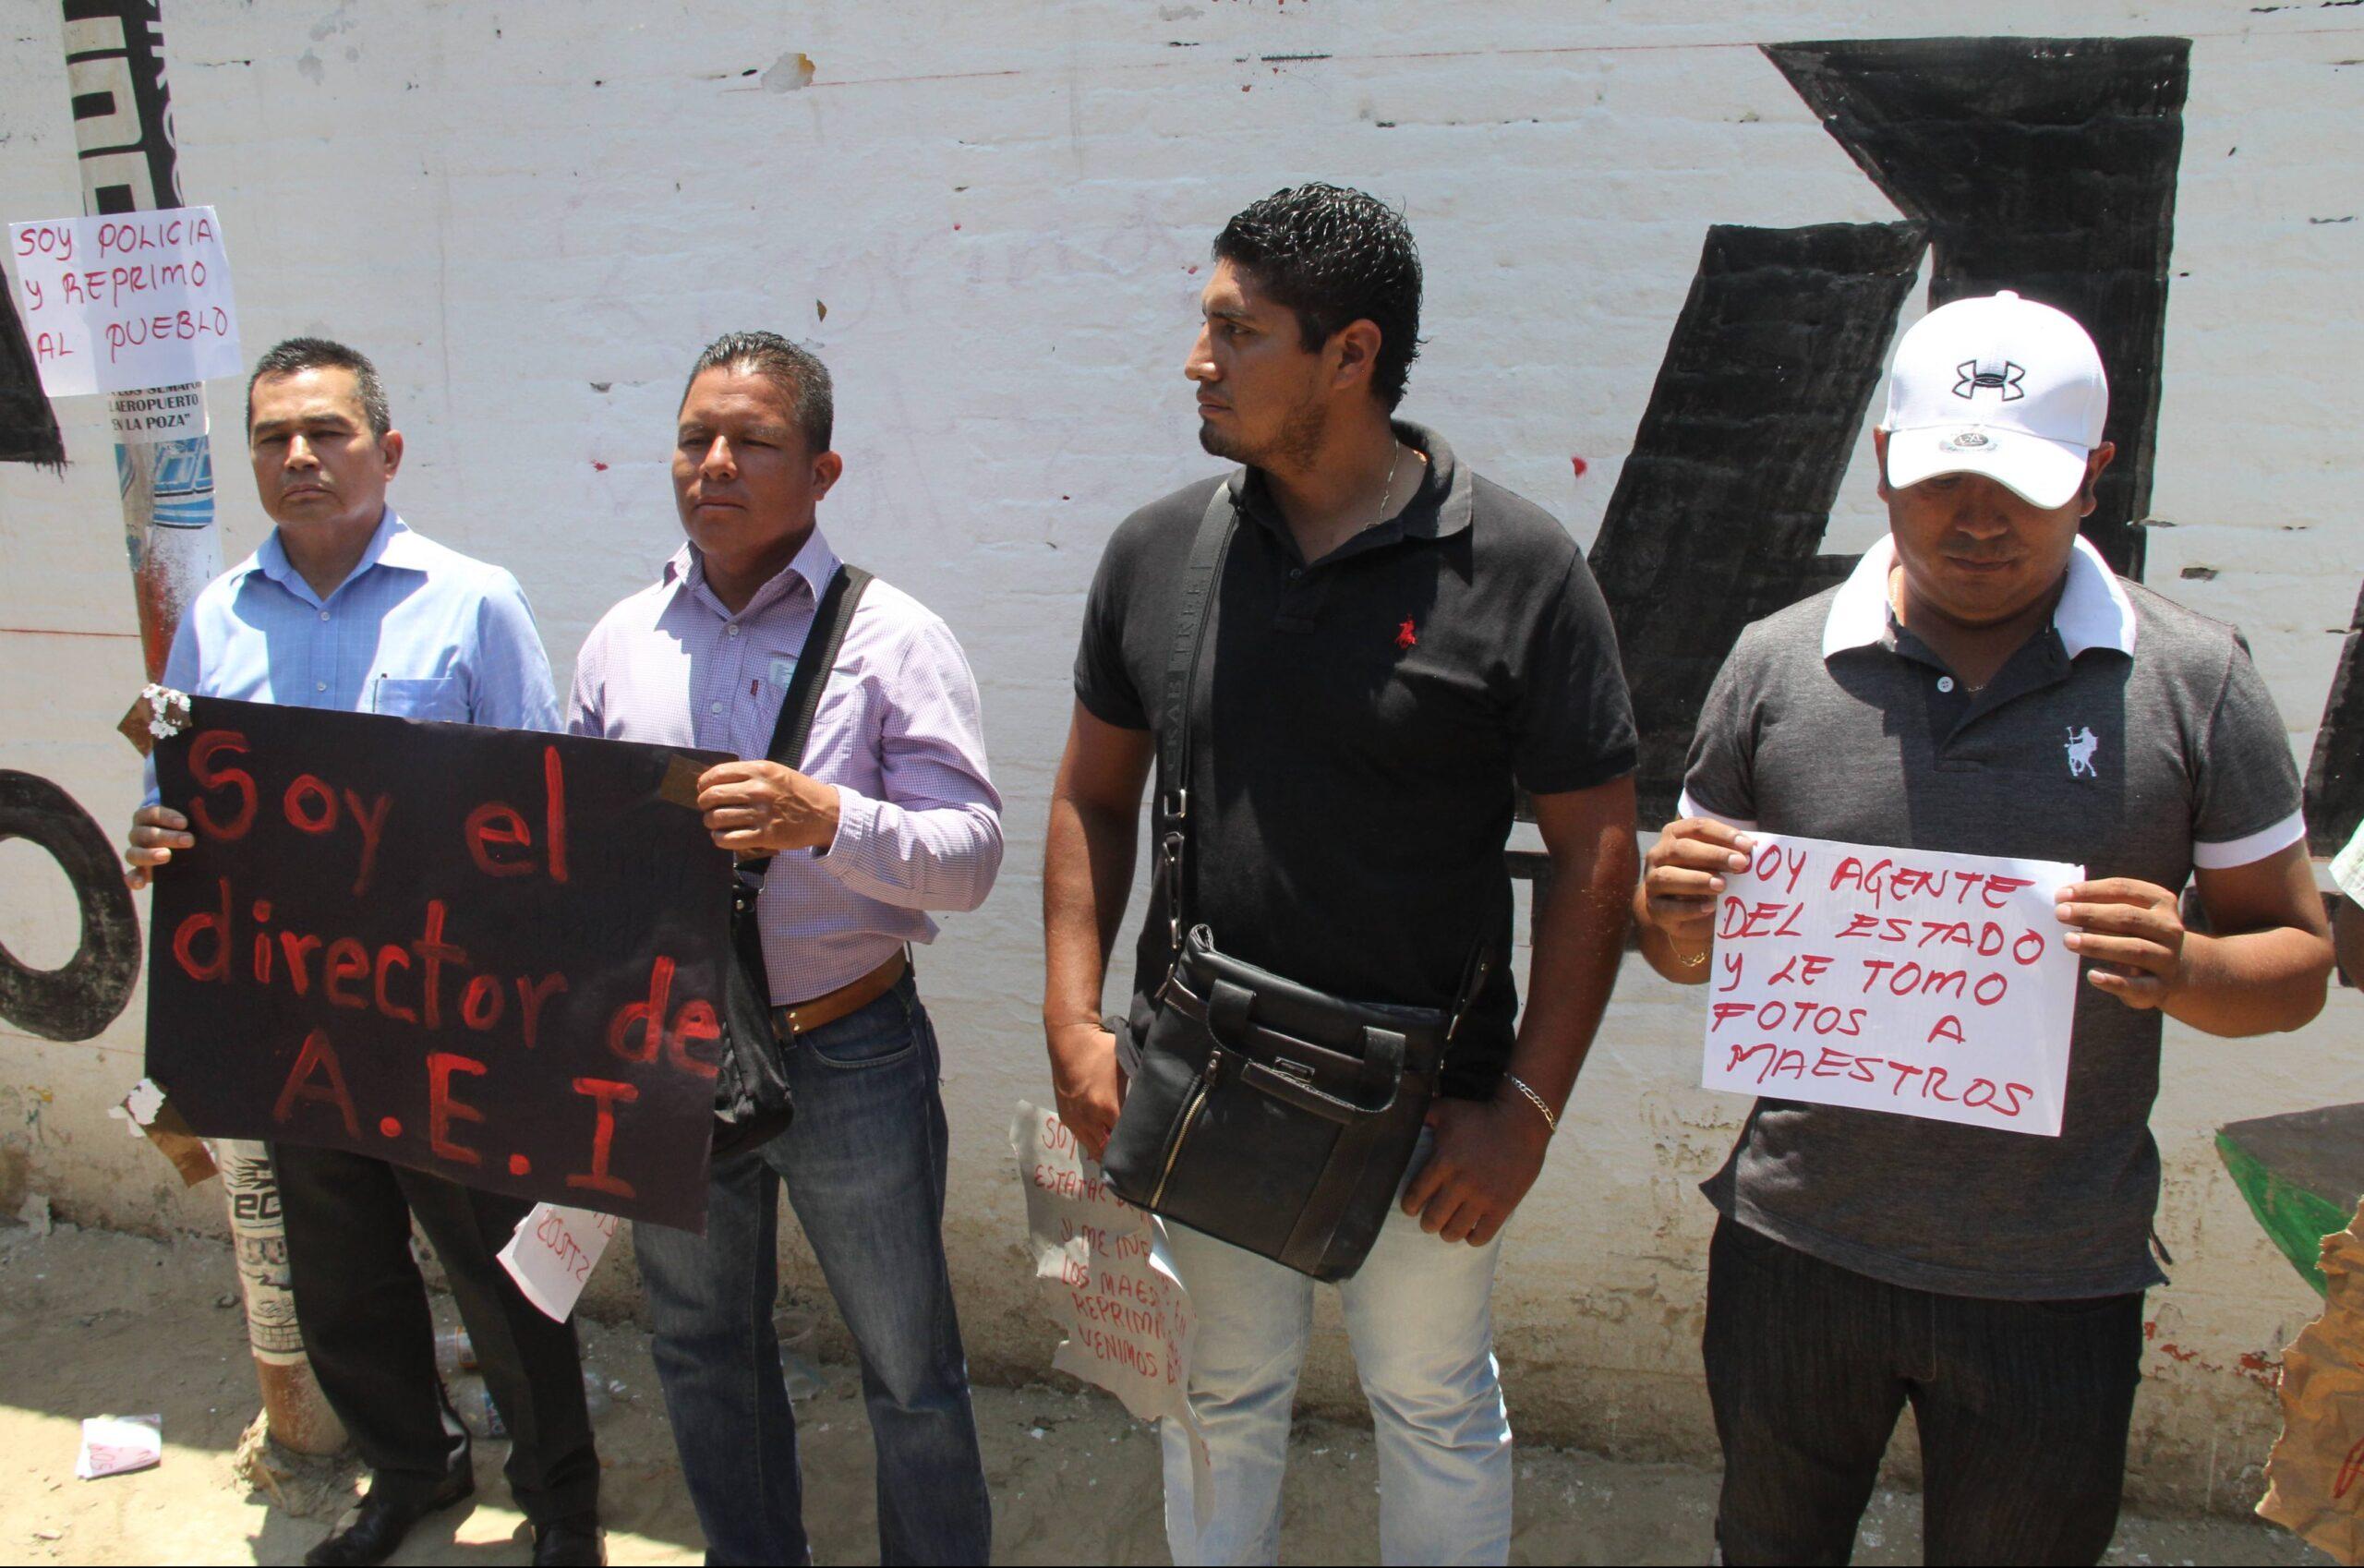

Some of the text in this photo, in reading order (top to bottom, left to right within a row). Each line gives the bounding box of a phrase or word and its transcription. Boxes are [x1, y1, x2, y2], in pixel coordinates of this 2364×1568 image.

[18, 217, 215, 261] SOY POLICIA
[63, 260, 207, 308] REPRIMO
[37, 306, 228, 365] AL PUEBLO
[127, 417, 142, 430] LA
[188, 729, 568, 897] Soy el
[1829, 855, 2036, 911] AGENTE
[1717, 895, 2046, 966] DEL ESTADO
[173, 876, 721, 1080] director de
[1767, 954, 1835, 987] LE
[1862, 959, 2008, 1007] TOMO
[1710, 999, 1967, 1045] FOTOS A
[1725, 1043, 2034, 1117] MAESTROS
